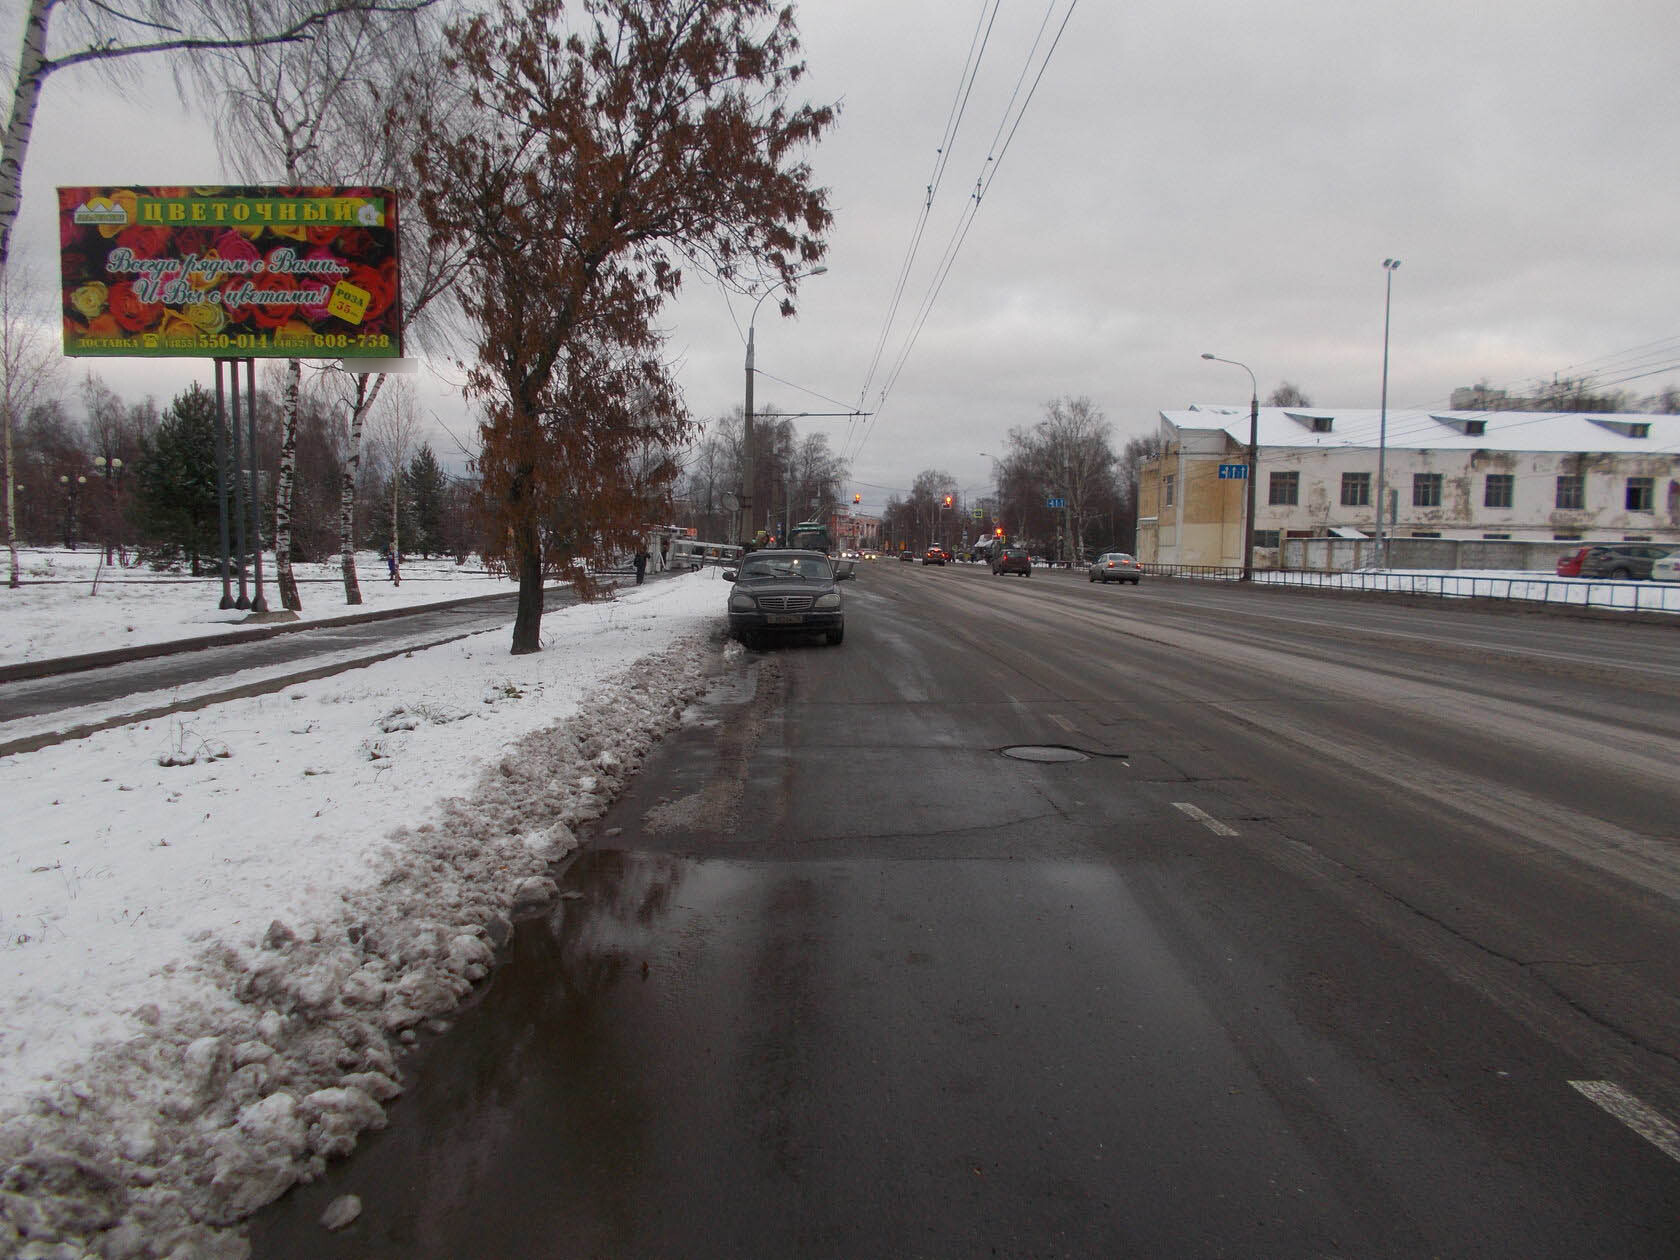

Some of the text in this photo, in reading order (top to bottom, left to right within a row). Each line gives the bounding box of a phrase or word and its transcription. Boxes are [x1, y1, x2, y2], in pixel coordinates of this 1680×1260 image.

[144, 201, 353, 223] ЦВЕТОЧНЫЙ
[106, 247, 350, 281] Всегда рядом с Вами...
[133, 278, 329, 309] И Вы с цветами!
[336, 288, 364, 307] РОЗА
[79, 337, 138, 348] ДОСТАВКА
[199, 334, 268, 349] 550-014
